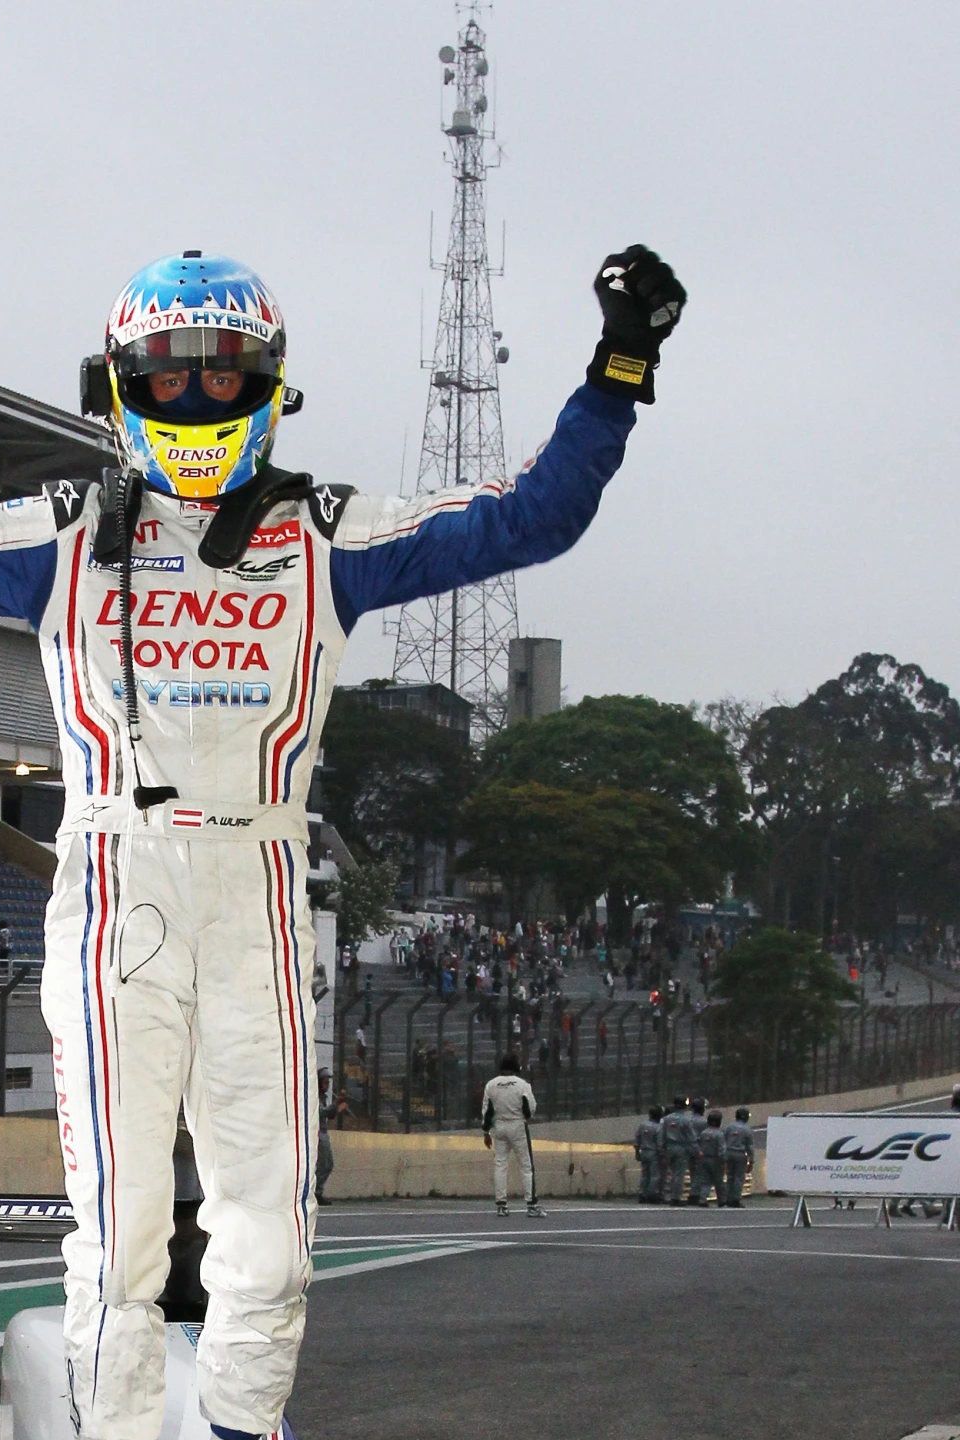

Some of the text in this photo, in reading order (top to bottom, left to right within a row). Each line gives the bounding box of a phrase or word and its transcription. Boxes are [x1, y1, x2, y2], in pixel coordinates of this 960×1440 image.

[124, 313, 186, 341] TOYOTA
[192, 311, 269, 338] HYBRID
[167, 447, 227, 461] DENSO
[178, 465, 219, 477] ZENT
[250, 528, 297, 544] OTAL
[237, 554, 301, 573] WEC
[96, 589, 287, 630] DENSO
[824, 1131, 952, 1162] WEC
[809, 1164, 842, 1172] WORLD
[843, 1165, 904, 1173] ENDURANCE
[829, 1172, 901, 1181] CHAMPIONSHIP
